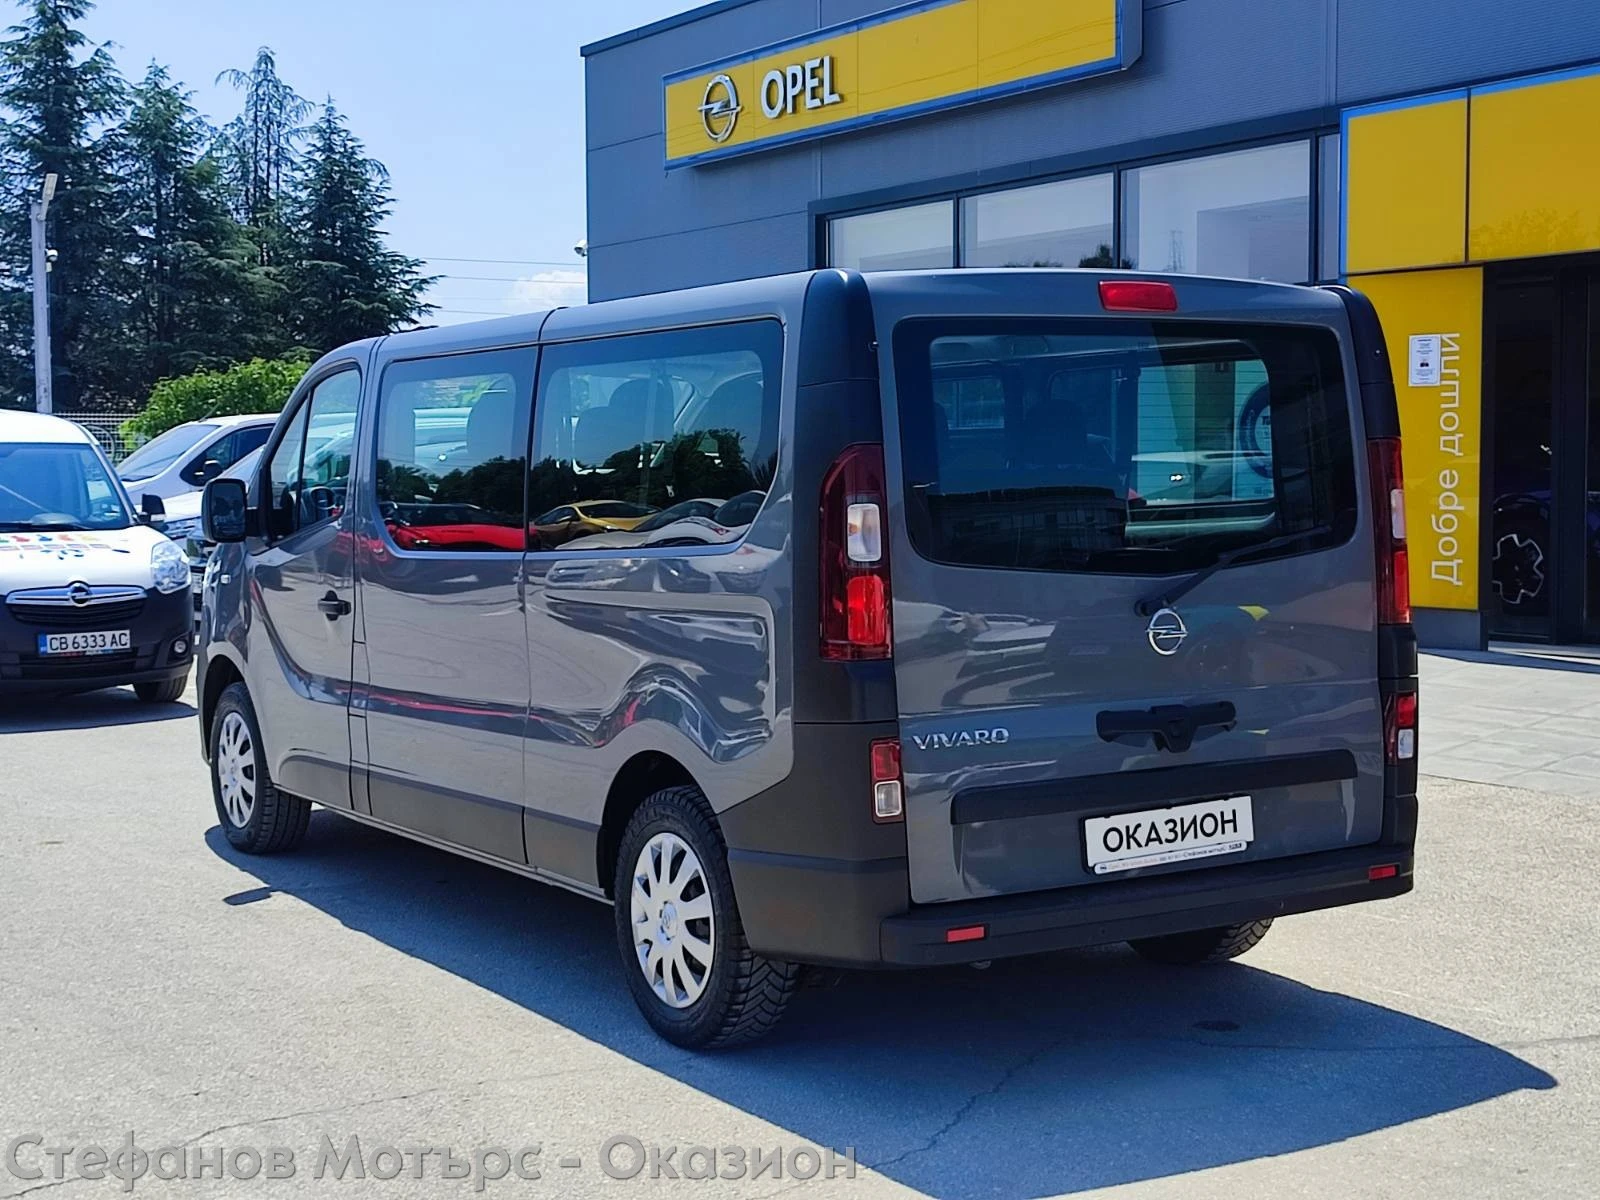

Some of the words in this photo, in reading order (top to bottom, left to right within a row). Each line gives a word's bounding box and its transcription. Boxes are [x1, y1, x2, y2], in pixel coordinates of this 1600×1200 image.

[761, 55, 842, 119] OPEL
[1438, 332, 1464, 457] дошли
[1430, 470, 1464, 586] Добре
[49, 636, 69, 651] CB
[71, 634, 107, 650] 6333
[110, 632, 129, 647] AC
[912, 728, 1009, 750] VIVARO
[1102, 808, 1238, 853] ОКАЗИОН
